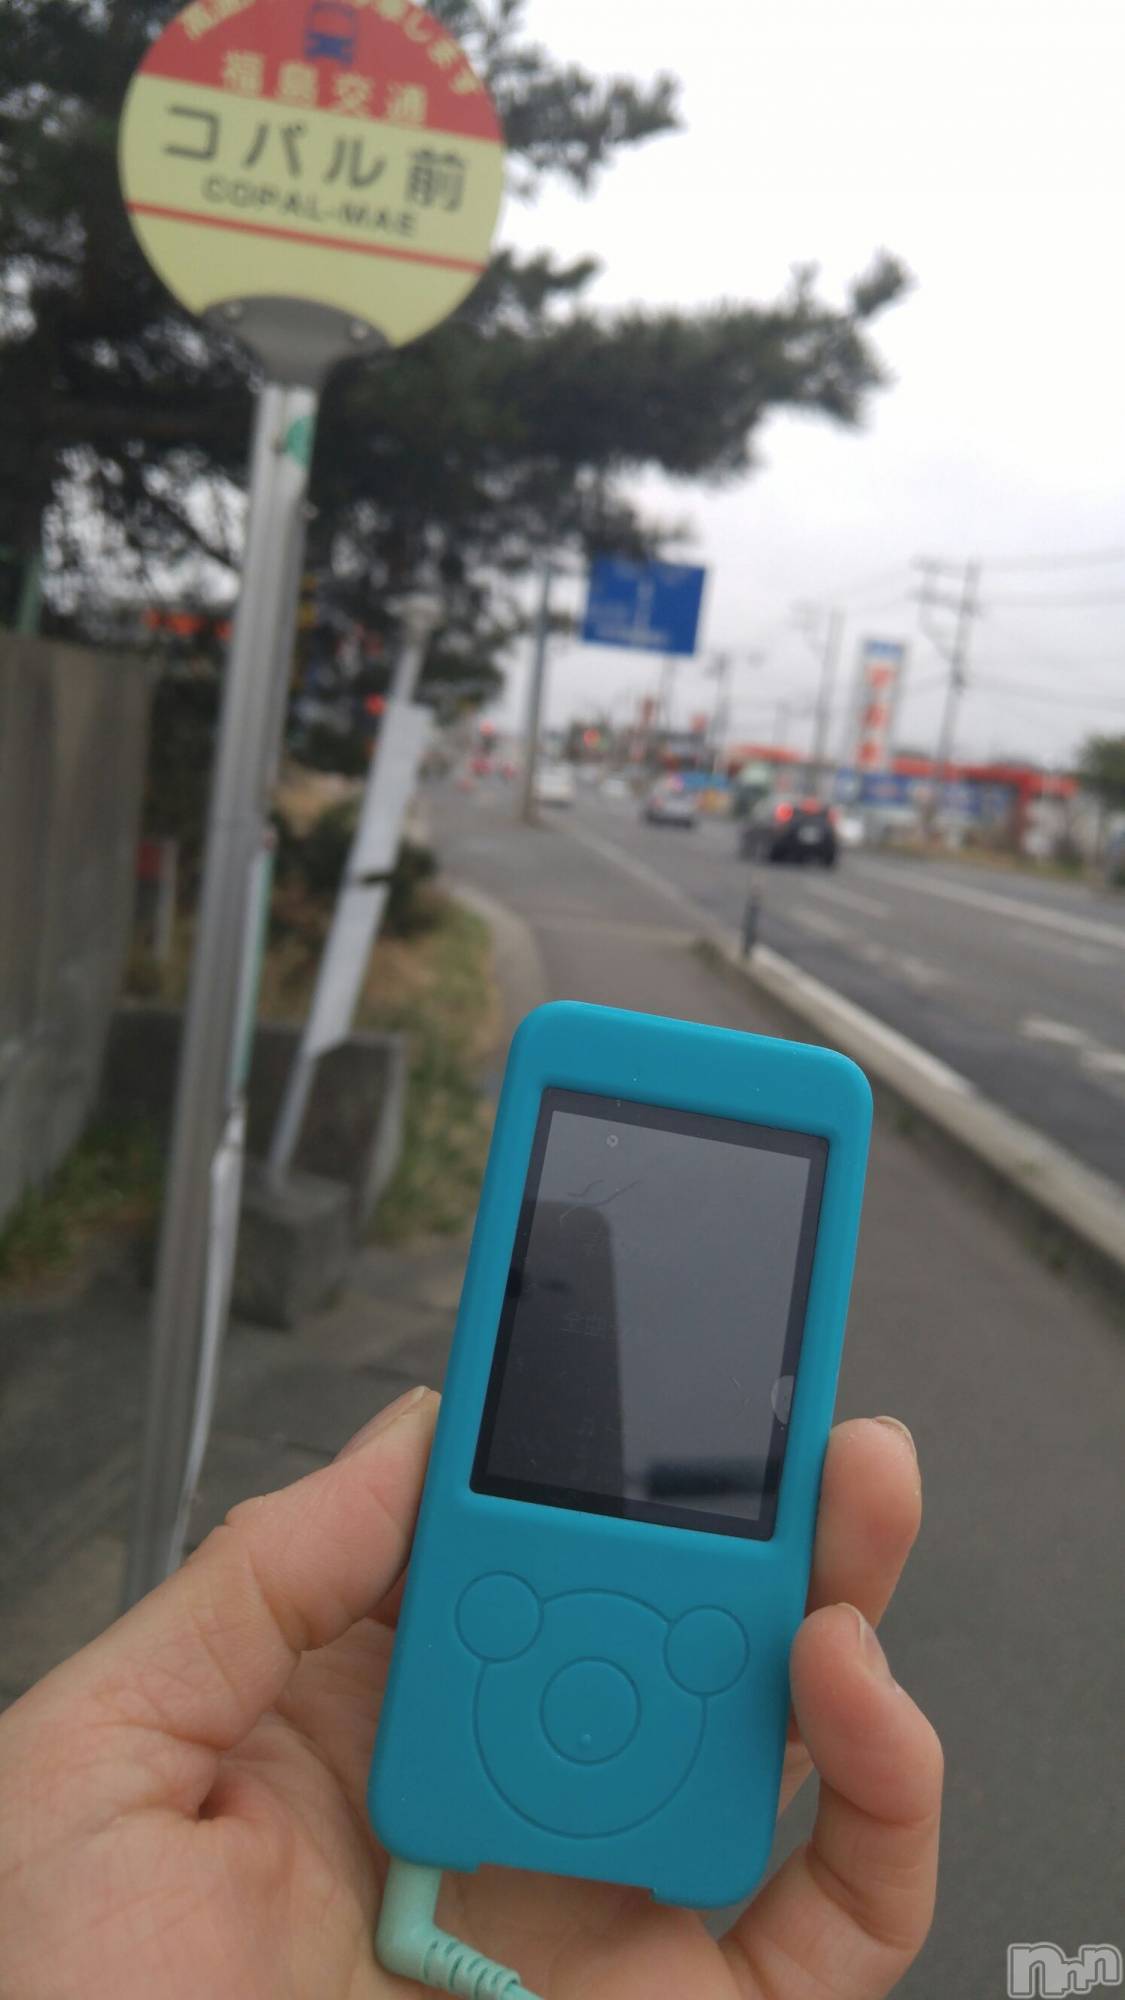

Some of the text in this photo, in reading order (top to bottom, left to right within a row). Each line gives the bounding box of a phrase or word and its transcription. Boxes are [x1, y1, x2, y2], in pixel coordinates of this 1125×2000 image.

[222, 50, 428, 127] 福島交通
[203, 174, 416, 238] COPAL-MAE
